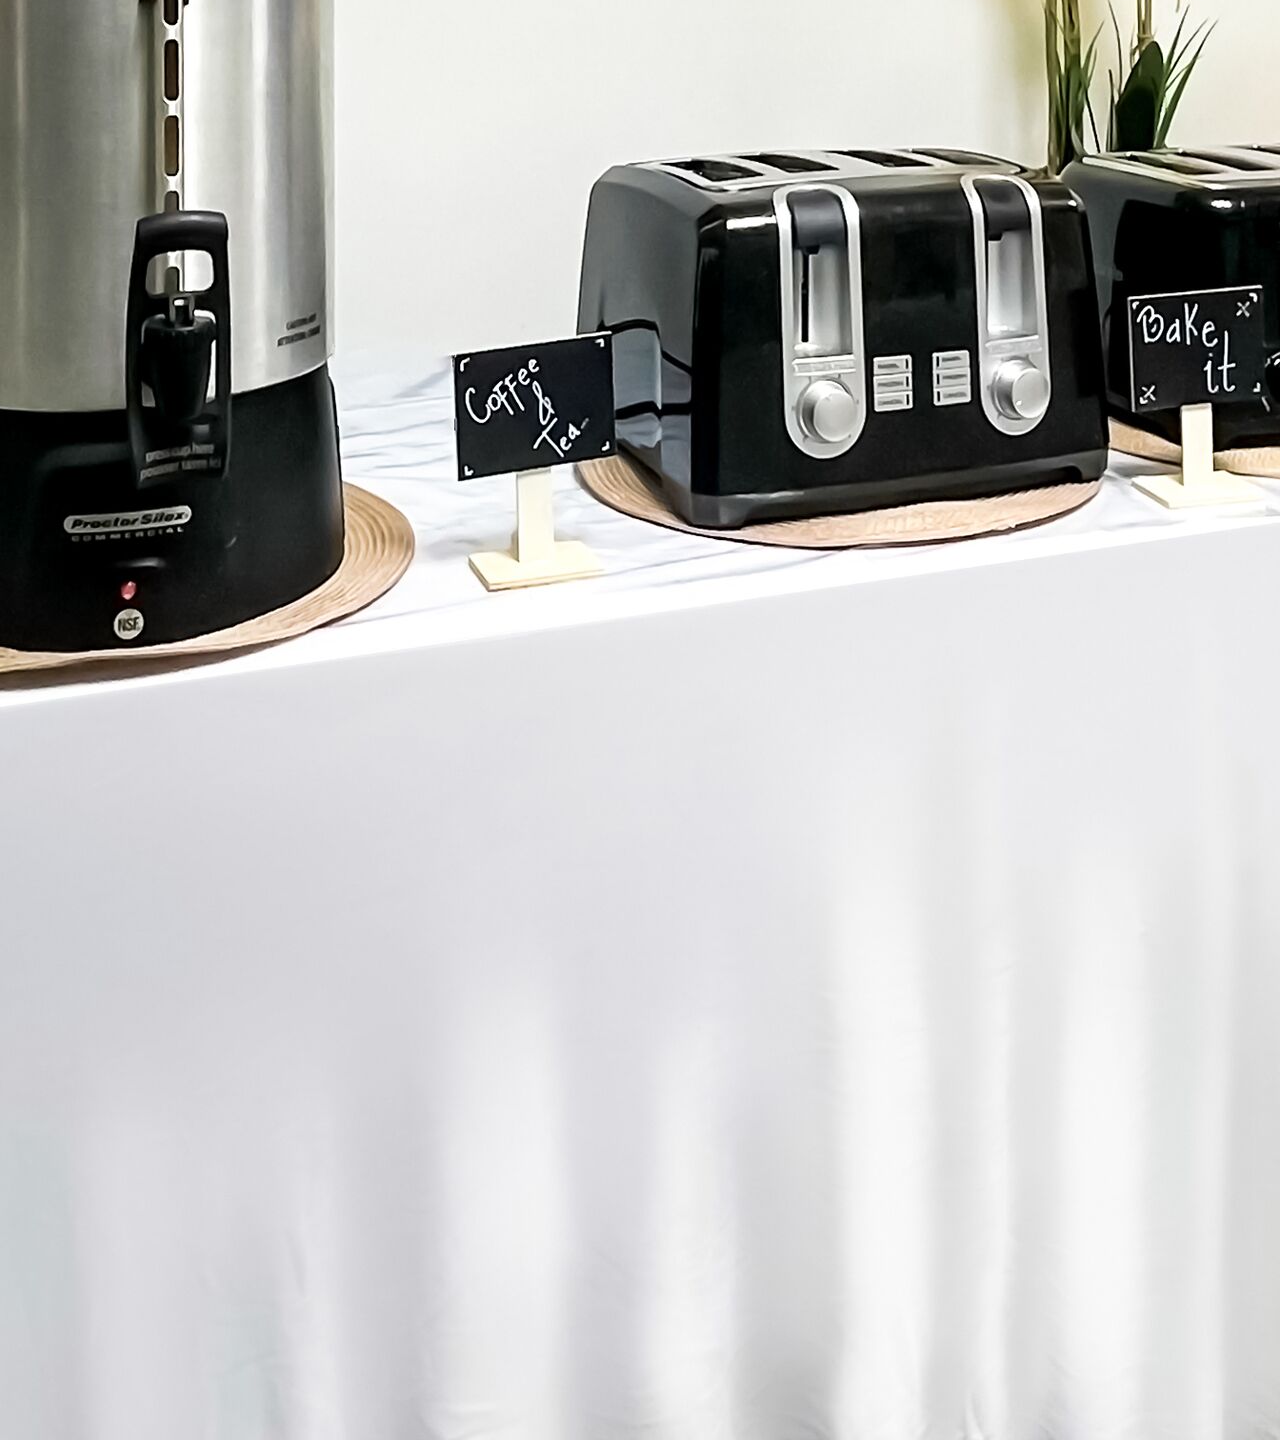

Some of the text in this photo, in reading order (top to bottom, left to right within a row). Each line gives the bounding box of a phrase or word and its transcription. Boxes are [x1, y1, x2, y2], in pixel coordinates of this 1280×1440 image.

[1203, 329, 1236, 393] it
[532, 381, 556, 426] &
[71, 525, 185, 543] COMMERCIAL
[117, 616, 140, 632] NSF
